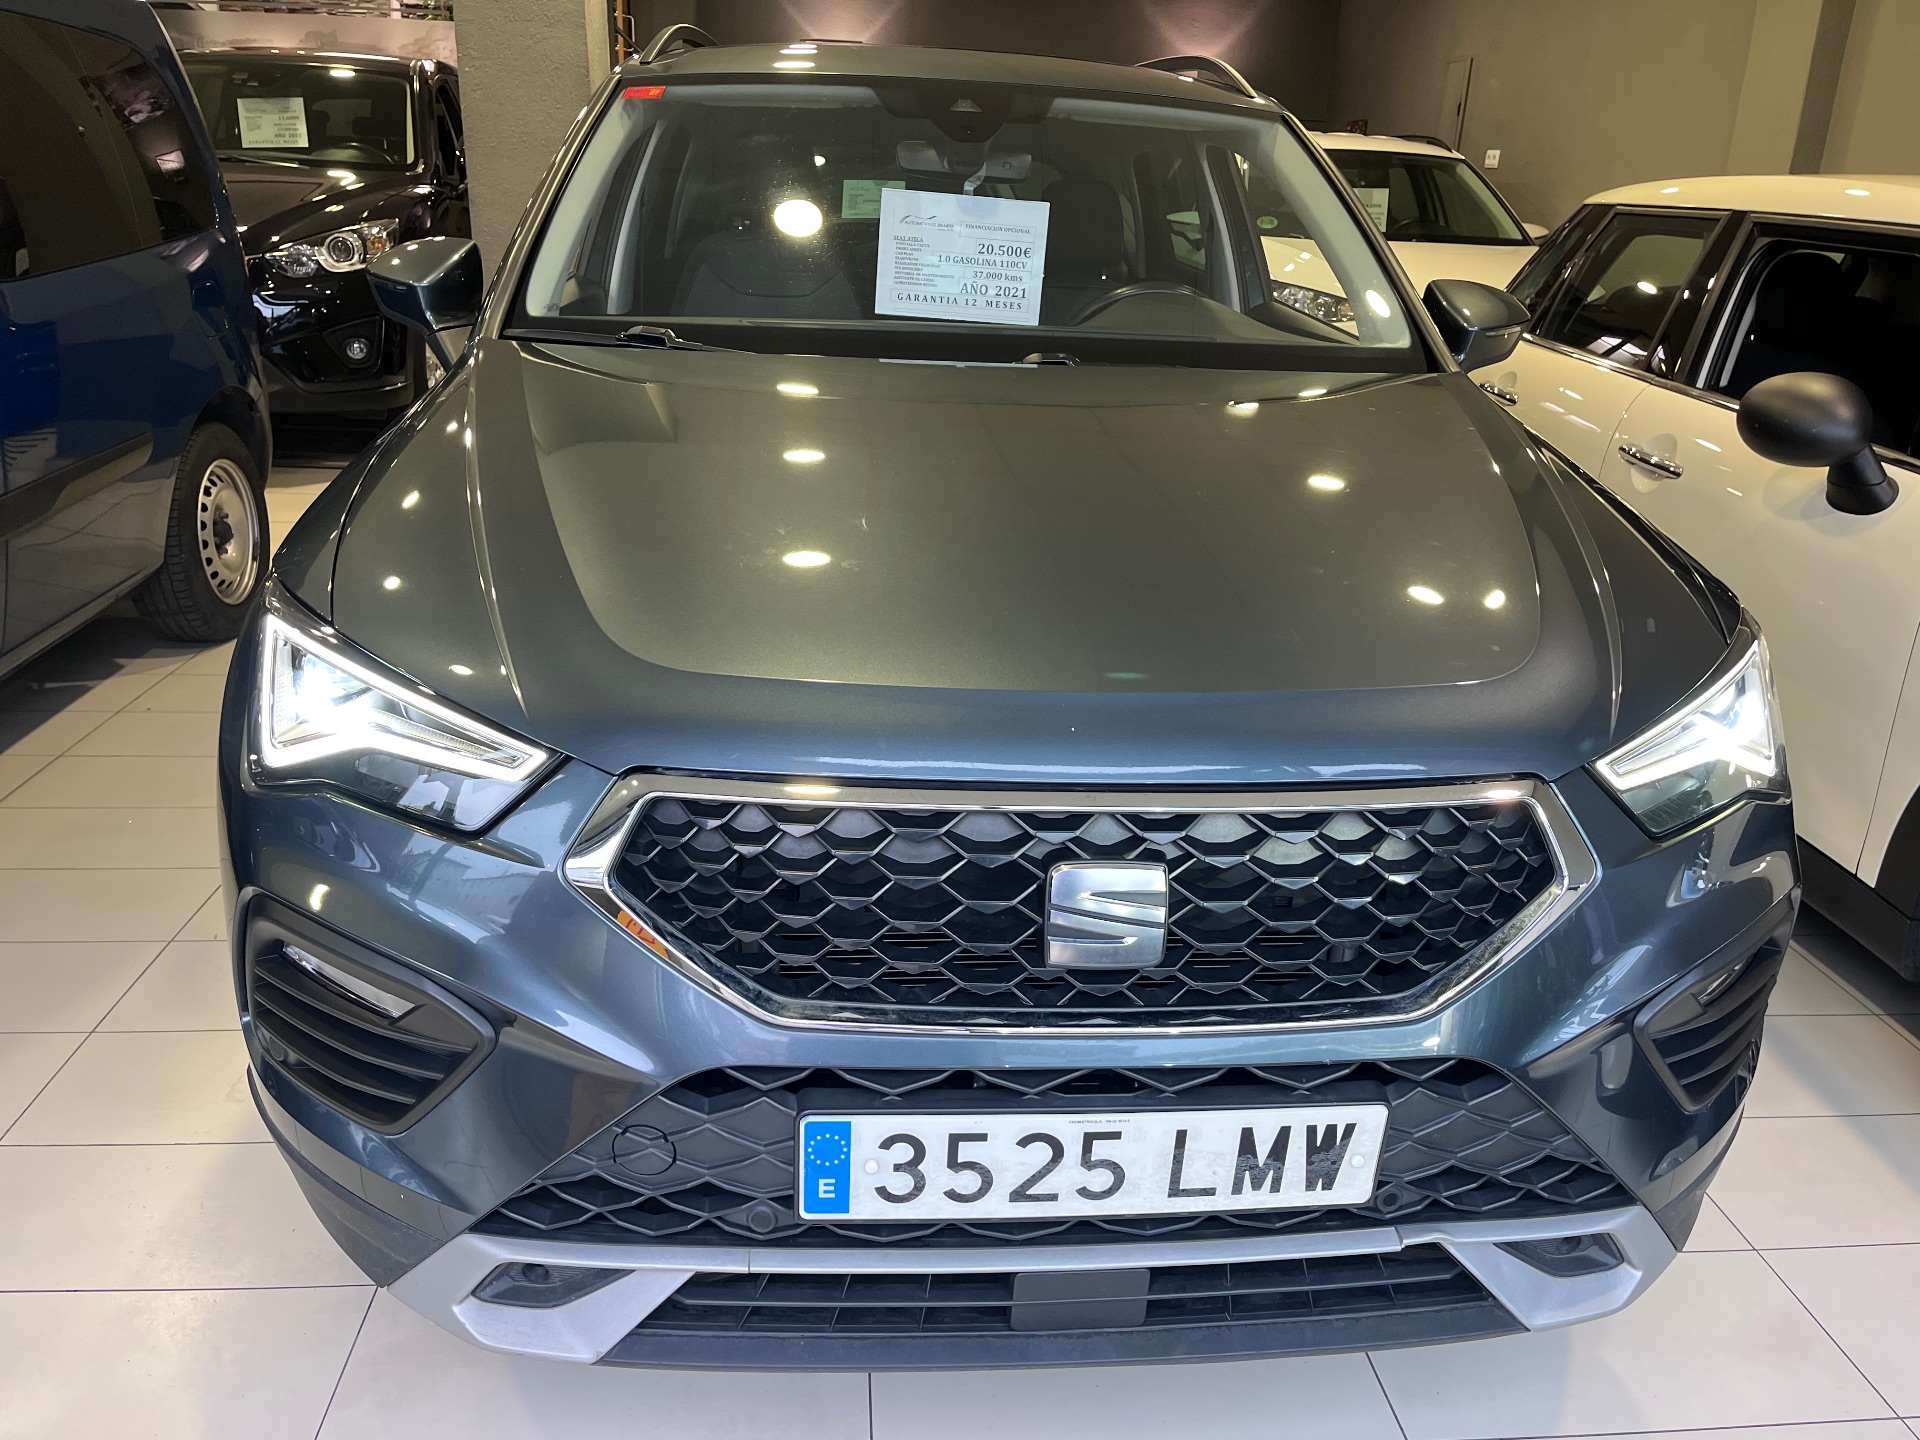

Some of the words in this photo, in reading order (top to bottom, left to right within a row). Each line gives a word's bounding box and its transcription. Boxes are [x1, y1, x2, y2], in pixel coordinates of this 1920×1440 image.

[977, 243, 1032, 258] 20.500€
[938, 255, 951, 264] 1.0
[953, 256, 997, 267] GASOLINA
[1000, 260, 1028, 270] 110CV
[973, 270, 1002, 280] 37.000
[1004, 273, 1023, 282] kms
[960, 280, 988, 296] AÑO
[995, 285, 1027, 299] 2021
[897, 292, 958, 305] GARANTIA
[965, 298, 977, 307] 12
[985, 300, 1022, 311] MESES
[873, 1130, 1126, 1204] 3525
[1166, 1123, 1358, 1199] LMW
[817, 1178, 836, 1198] E
